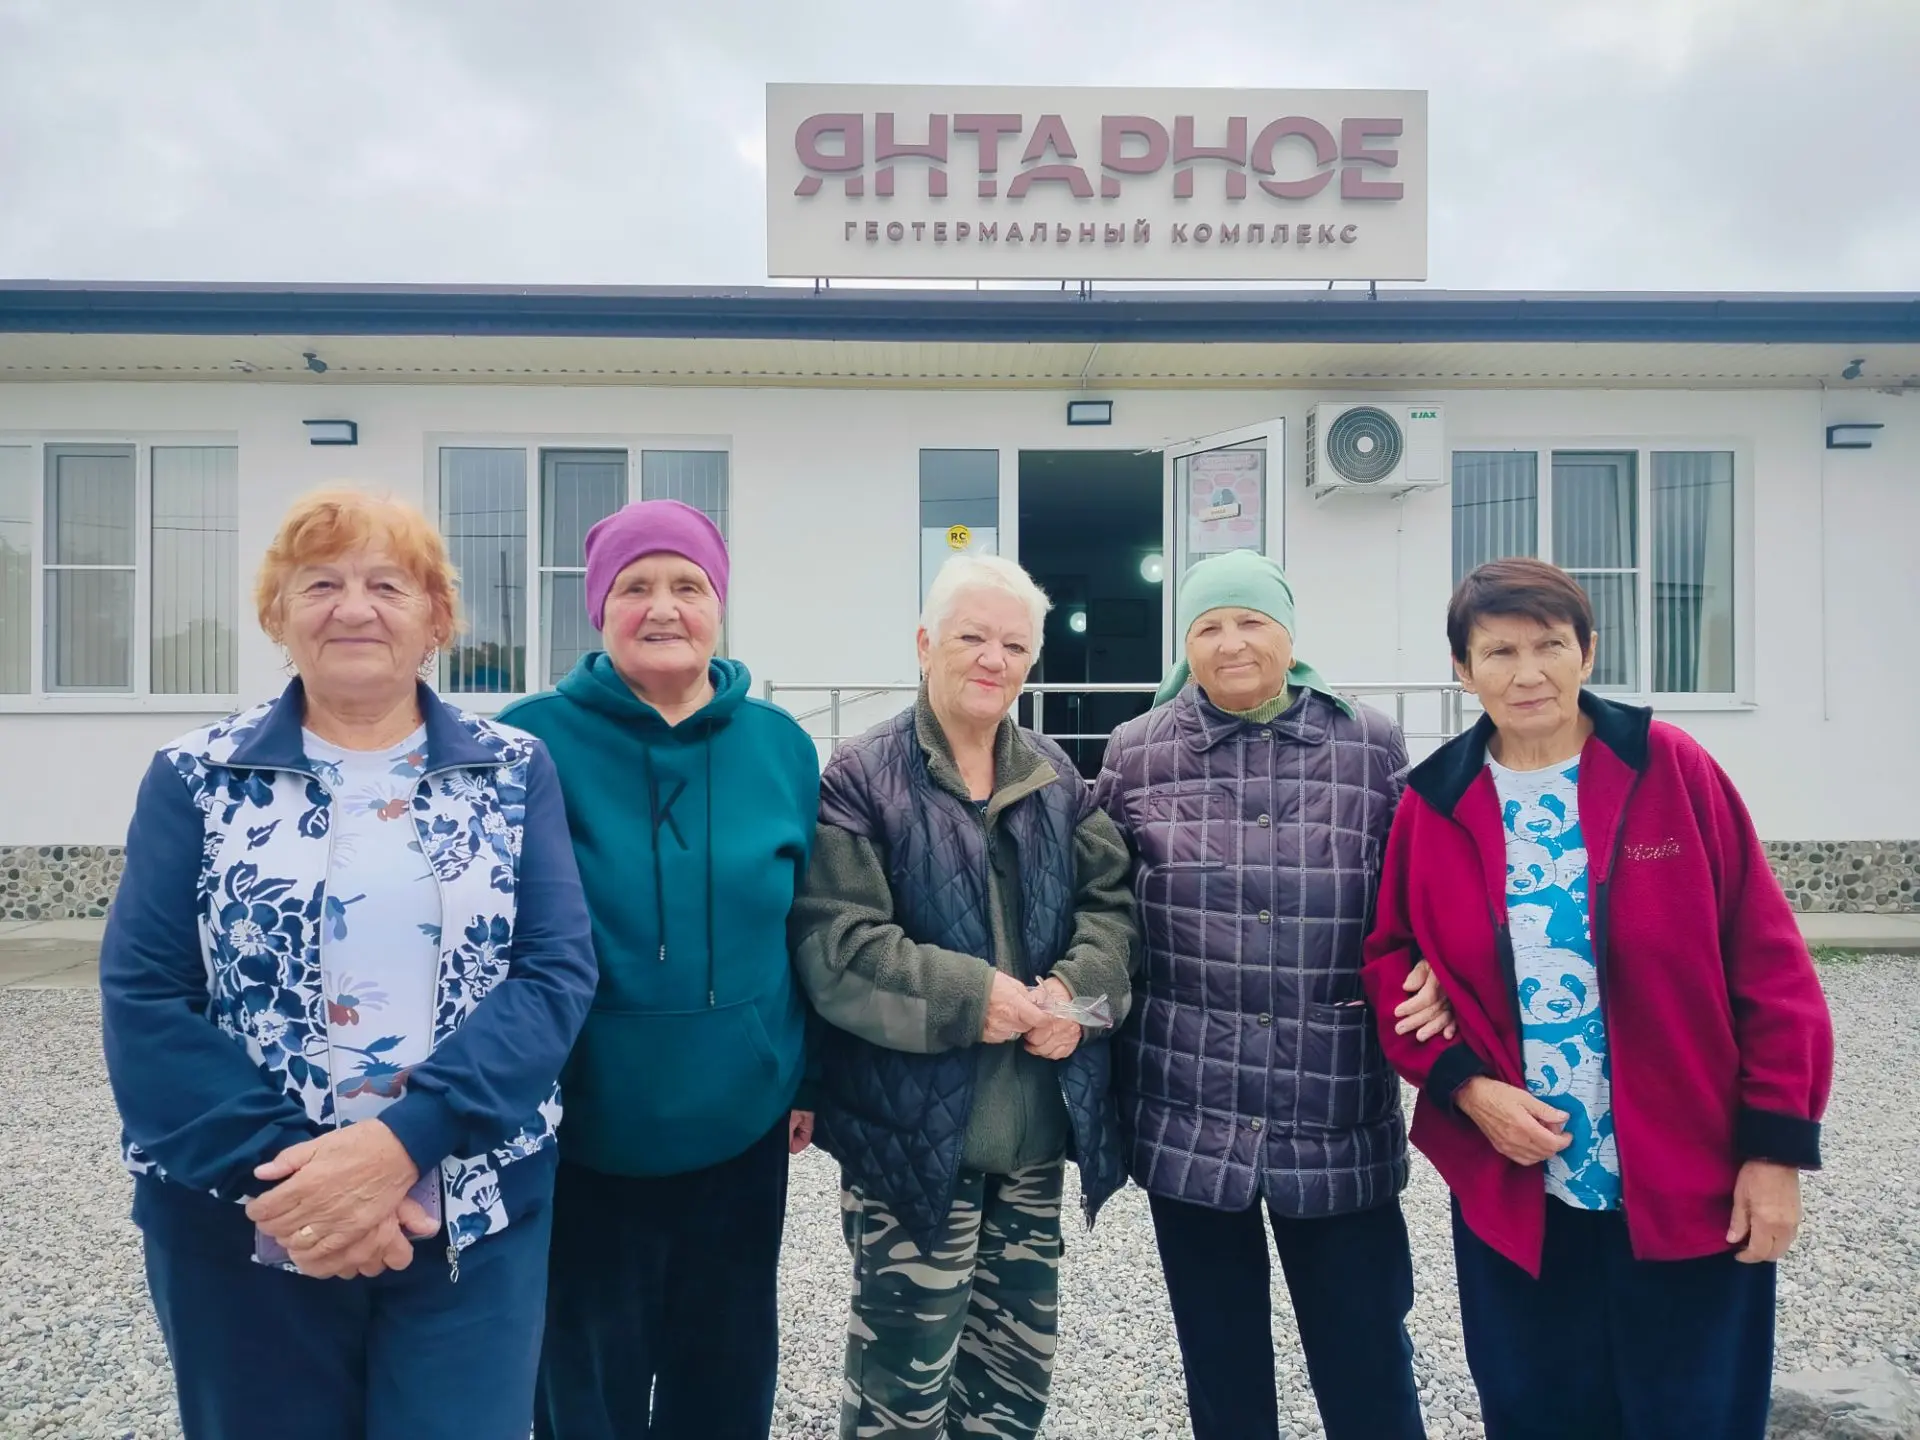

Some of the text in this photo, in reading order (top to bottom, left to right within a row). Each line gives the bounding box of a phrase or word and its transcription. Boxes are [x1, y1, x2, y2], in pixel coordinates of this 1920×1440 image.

[794, 113, 1403, 200] ЯНТАРНОЕ
[845, 219, 1358, 244] ГЕОТЕРМАЛЬНЫЙ КОМПЛЕКС
